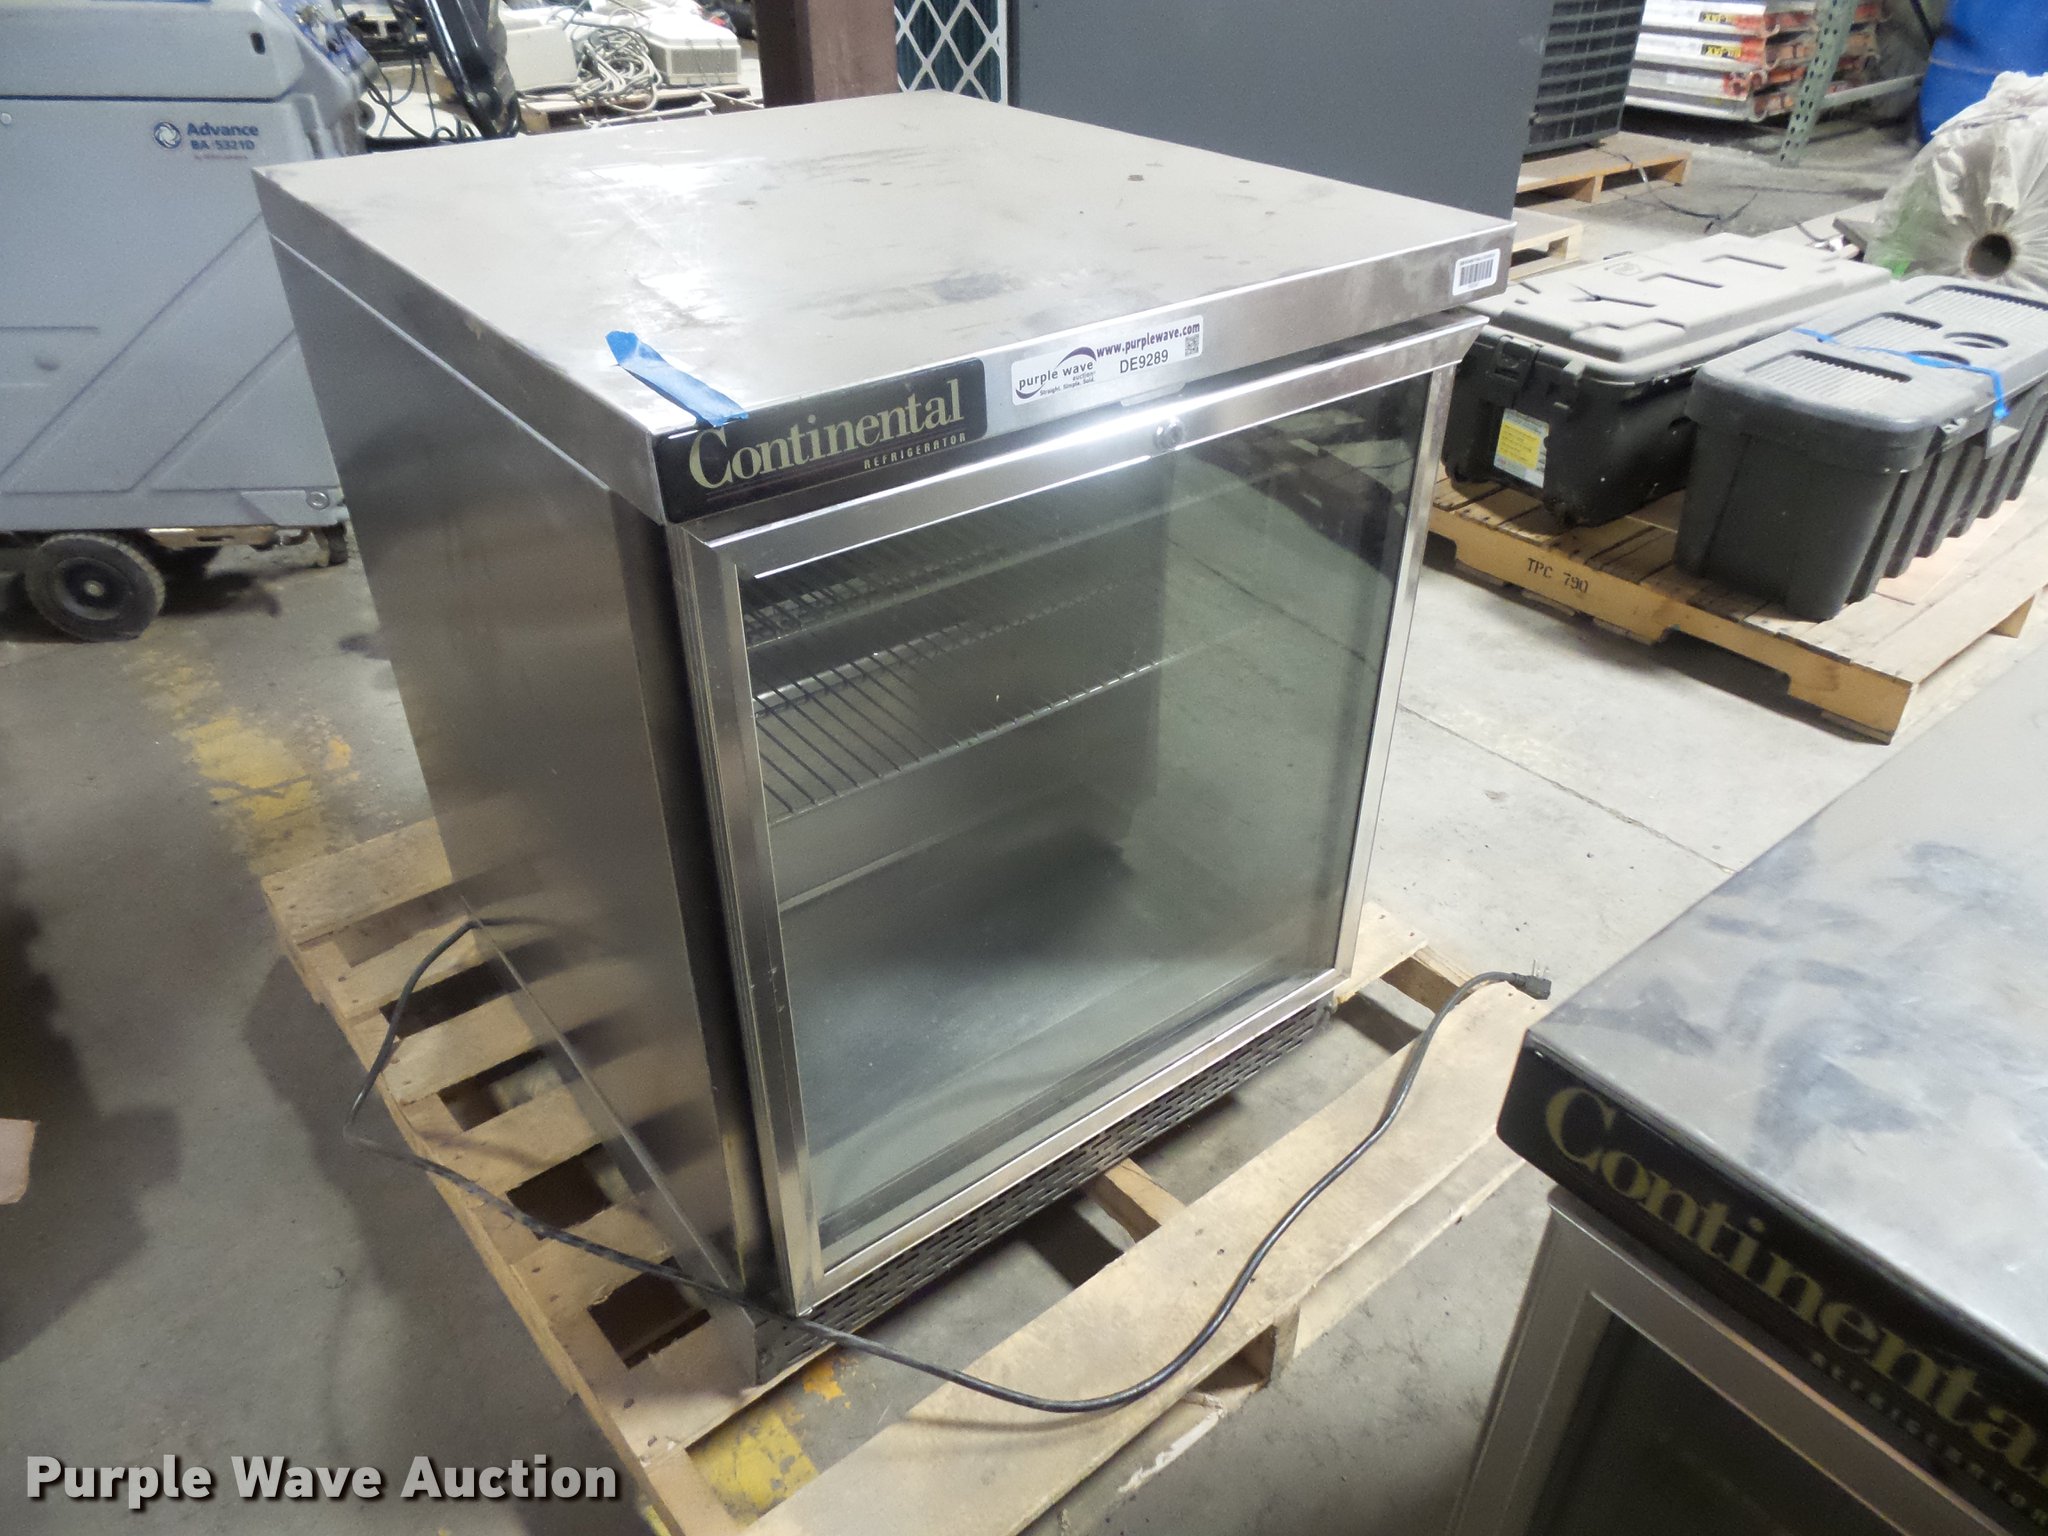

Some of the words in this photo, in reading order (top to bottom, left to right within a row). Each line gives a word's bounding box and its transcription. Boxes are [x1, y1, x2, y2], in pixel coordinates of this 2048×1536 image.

[187, 122, 259, 136] Advance
[1096, 322, 1200, 358] www.purplewave.com
[1018, 368, 1058, 391] purple
[1062, 360, 1094, 377] wave
[1119, 349, 1169, 374] DE9289
[688, 378, 965, 489] Continental
[863, 432, 967, 470] REFRIGERATOR
[1527, 558, 1553, 579] TPC
[1562, 572, 1589, 593] 790
[1545, 1086, 2048, 1490] Continenta
